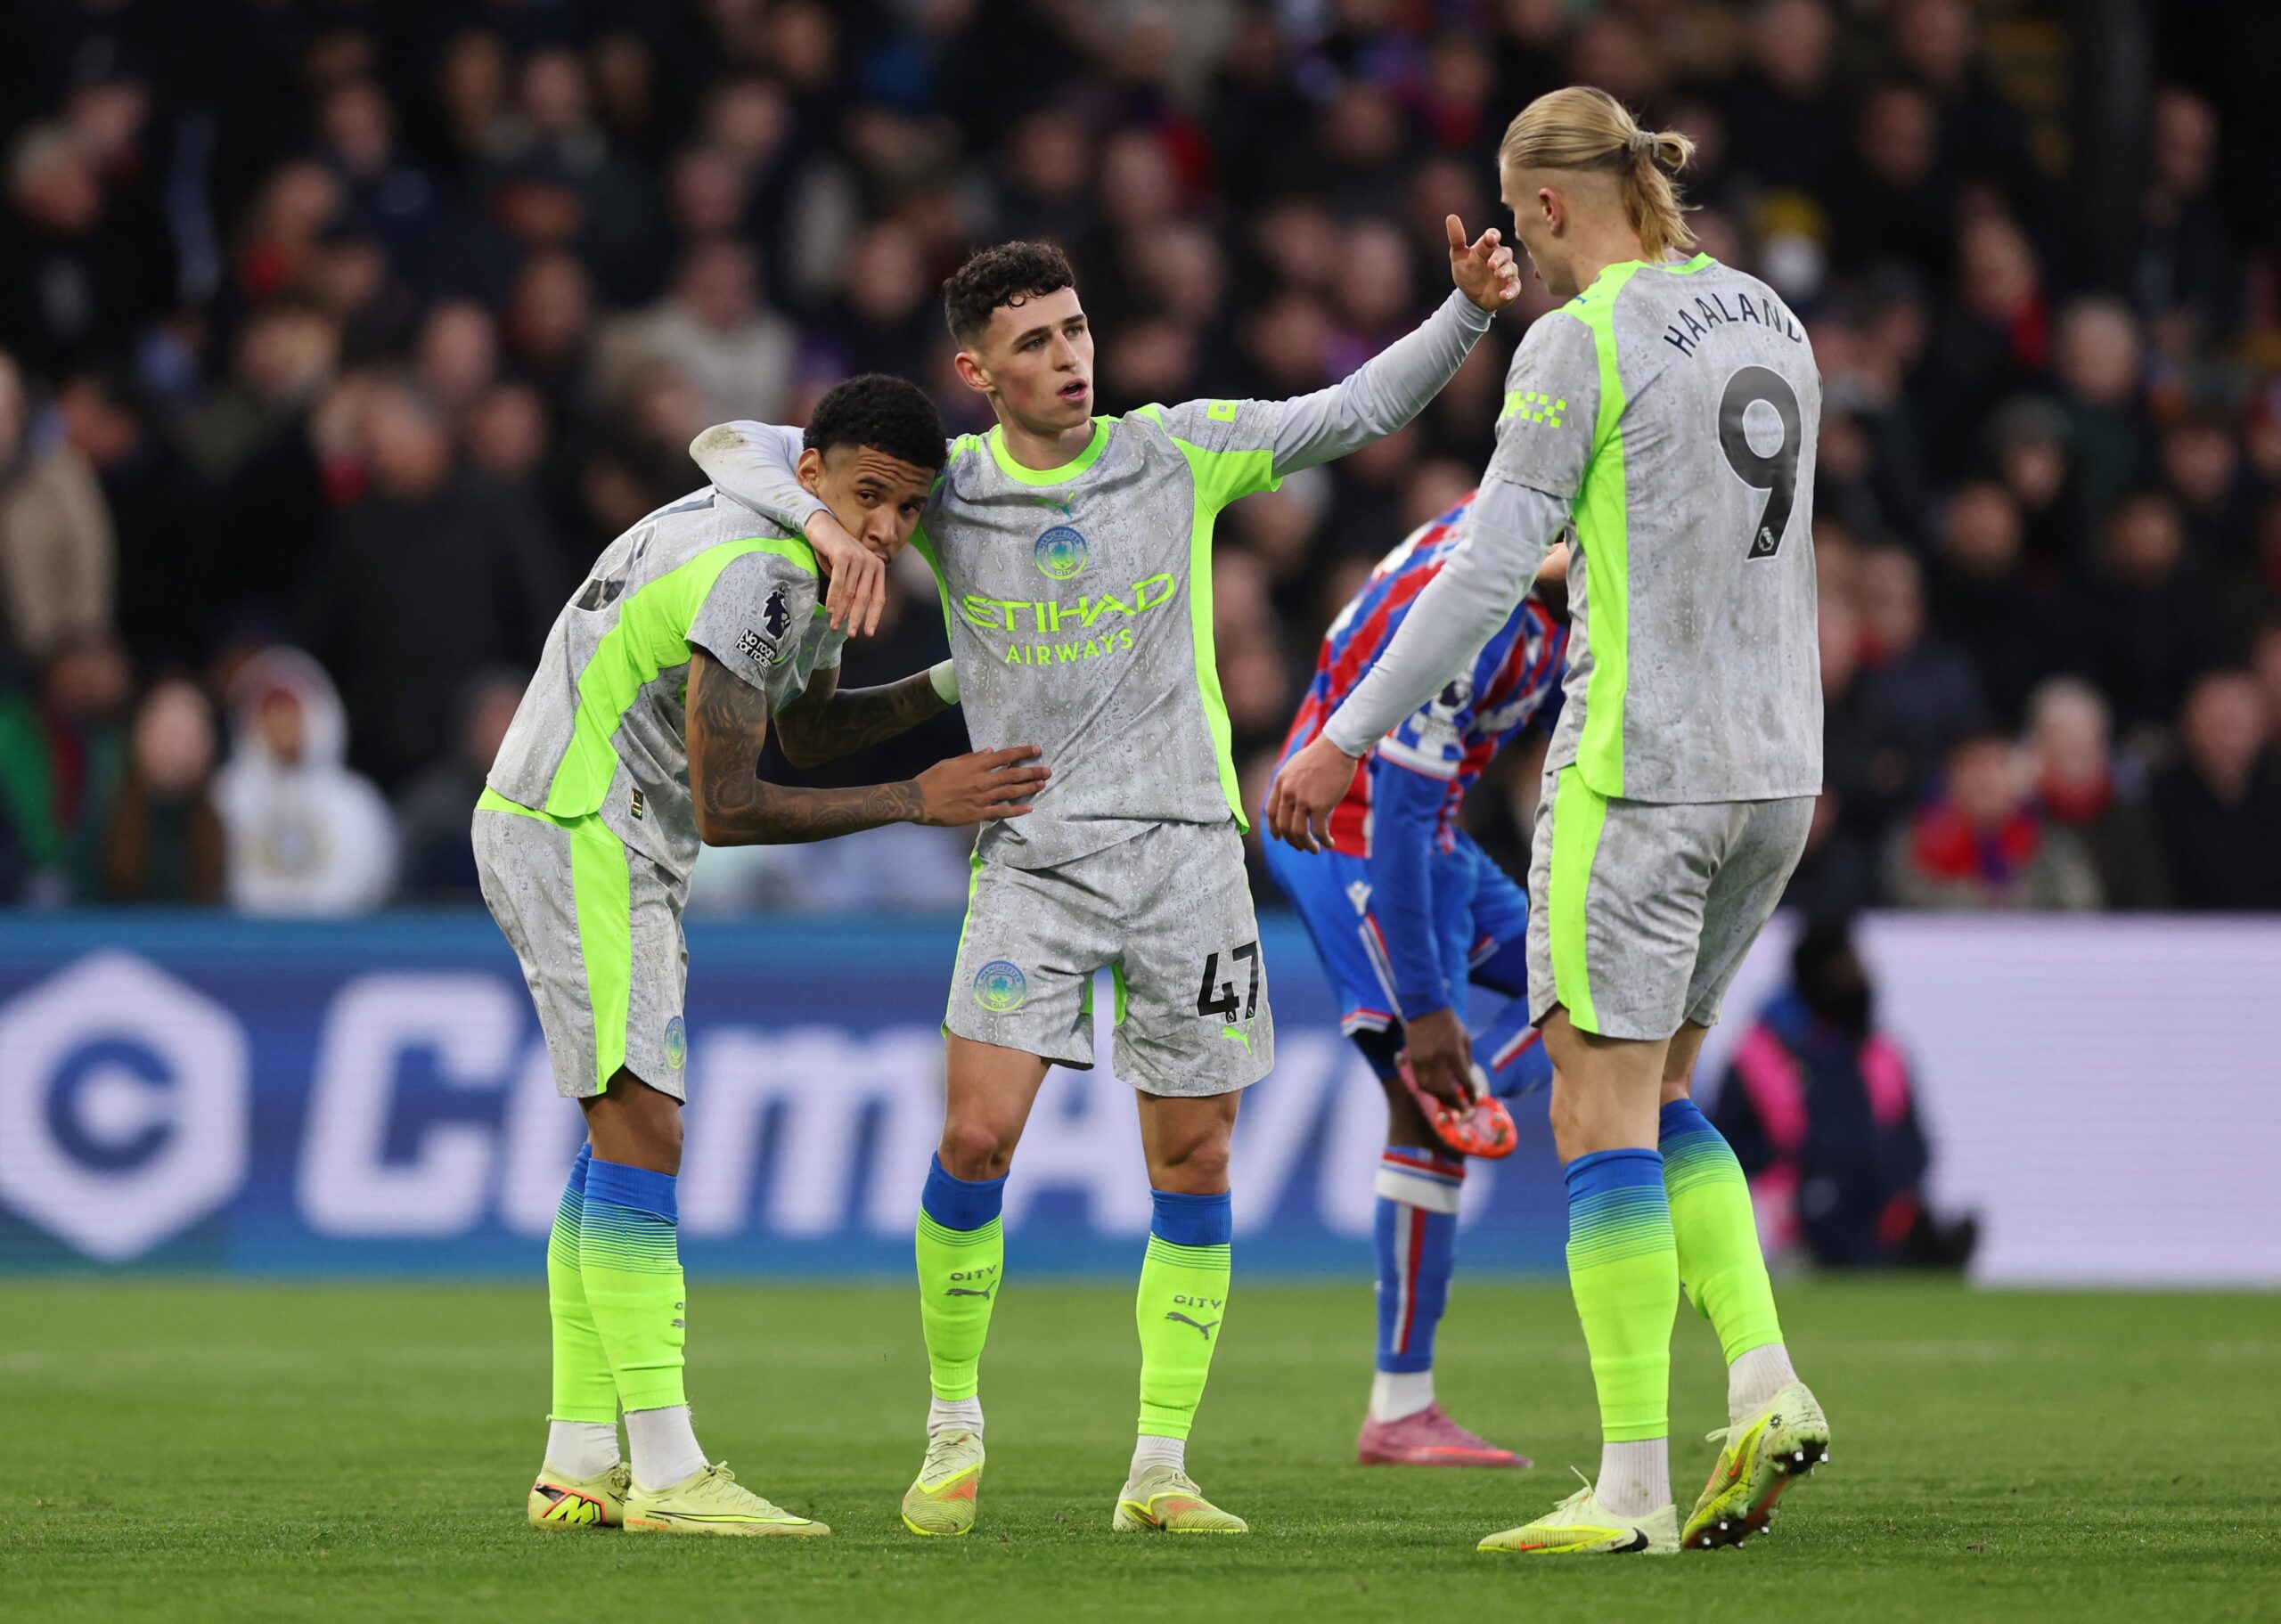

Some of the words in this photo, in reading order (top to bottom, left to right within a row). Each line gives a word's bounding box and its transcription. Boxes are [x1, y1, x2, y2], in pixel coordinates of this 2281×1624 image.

[1717, 364, 1803, 560] 9
[962, 573, 1175, 633] ETIHAD
[740, 628, 757, 646] No
[1004, 628, 1134, 665] AIRWAYS
[1197, 940, 1259, 1024] 47
[950, 1264, 996, 1281] CITY
[1173, 1294, 1222, 1310] CITY
